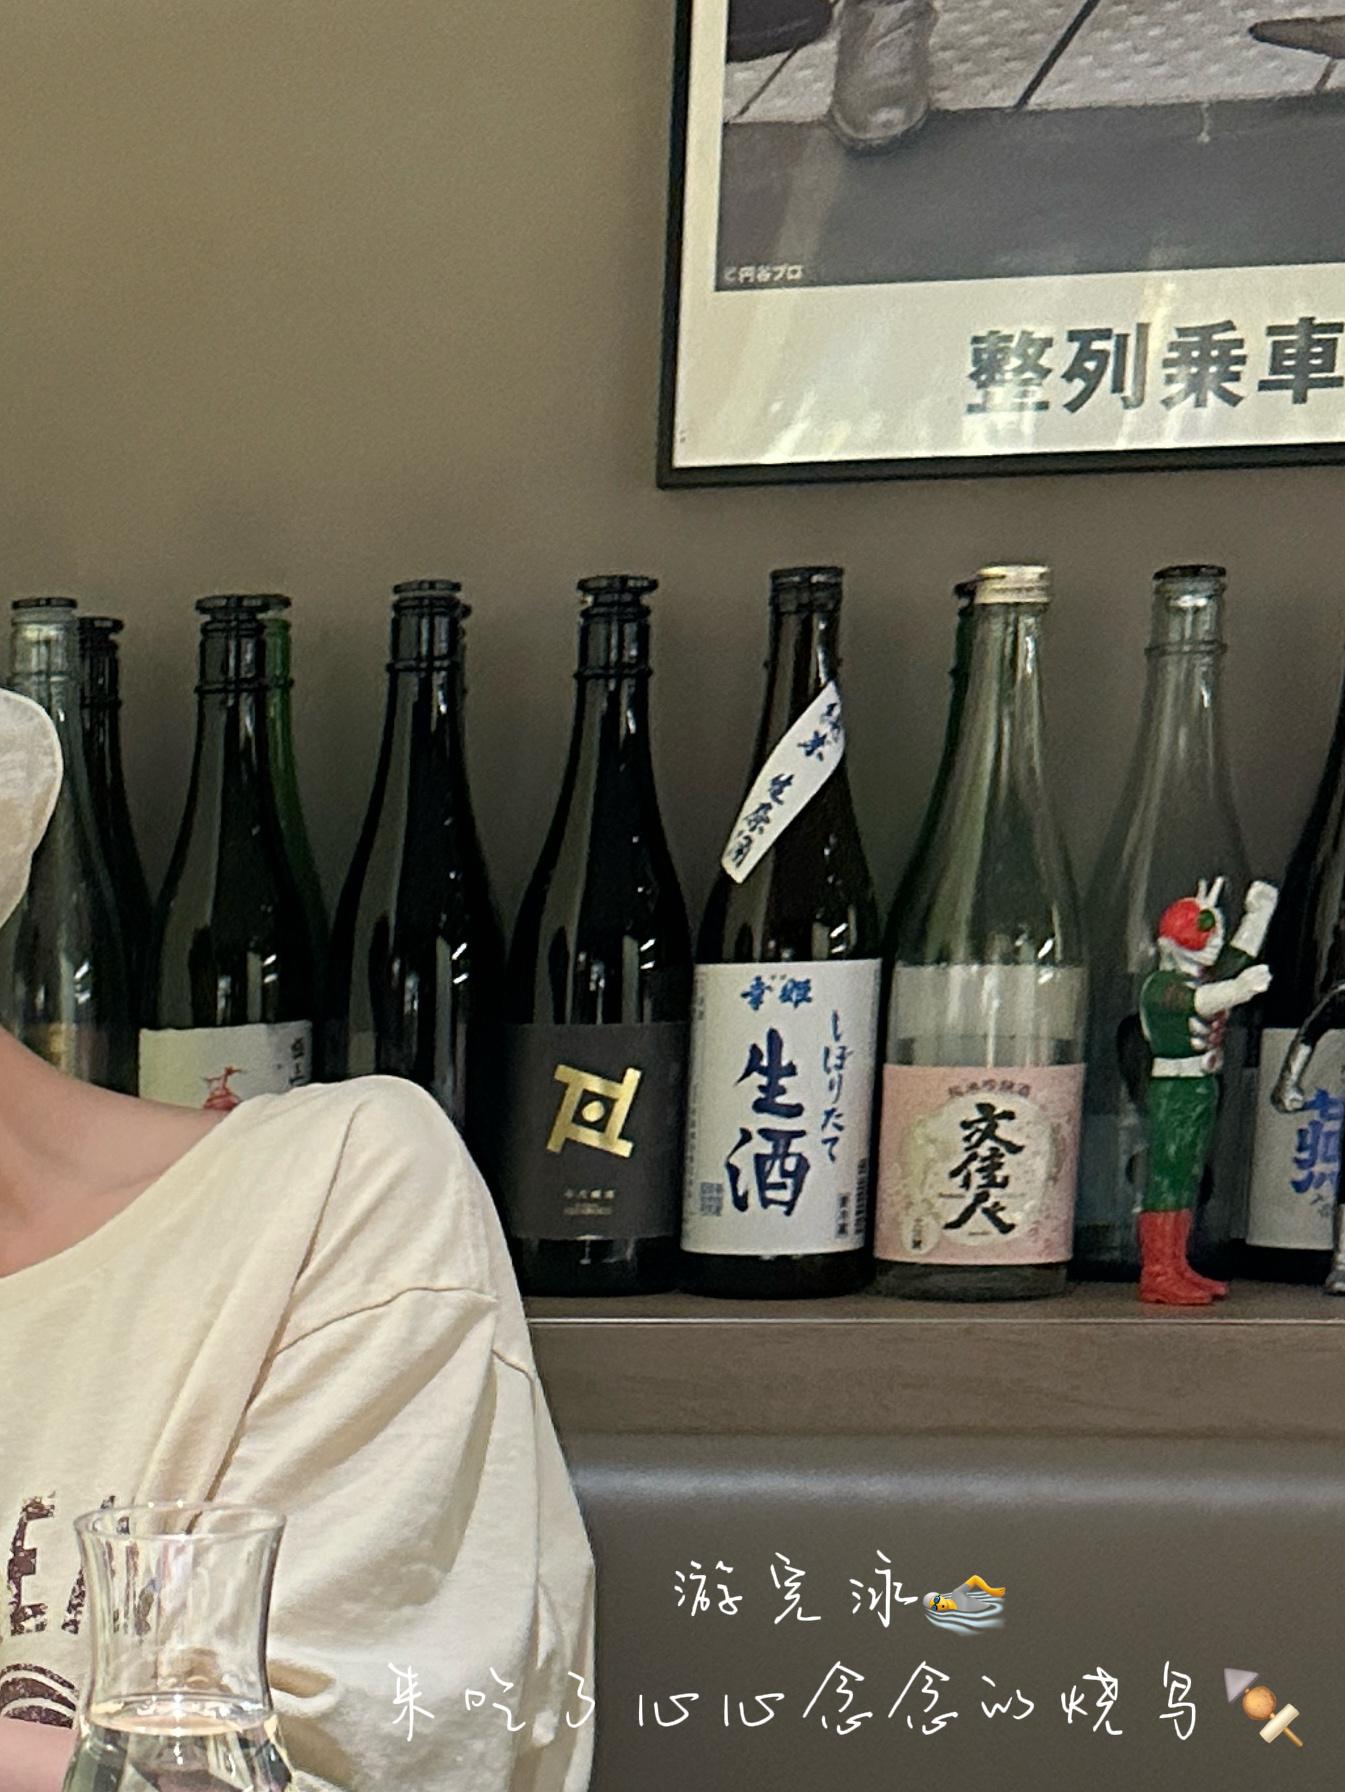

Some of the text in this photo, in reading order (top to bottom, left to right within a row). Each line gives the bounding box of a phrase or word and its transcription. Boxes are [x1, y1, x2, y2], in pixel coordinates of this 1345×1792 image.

[966, 315, 1345, 414] 整列乗車
[725, 1027, 811, 1217] 生酒
[821, 1008, 853, 1163] しぼりたて
